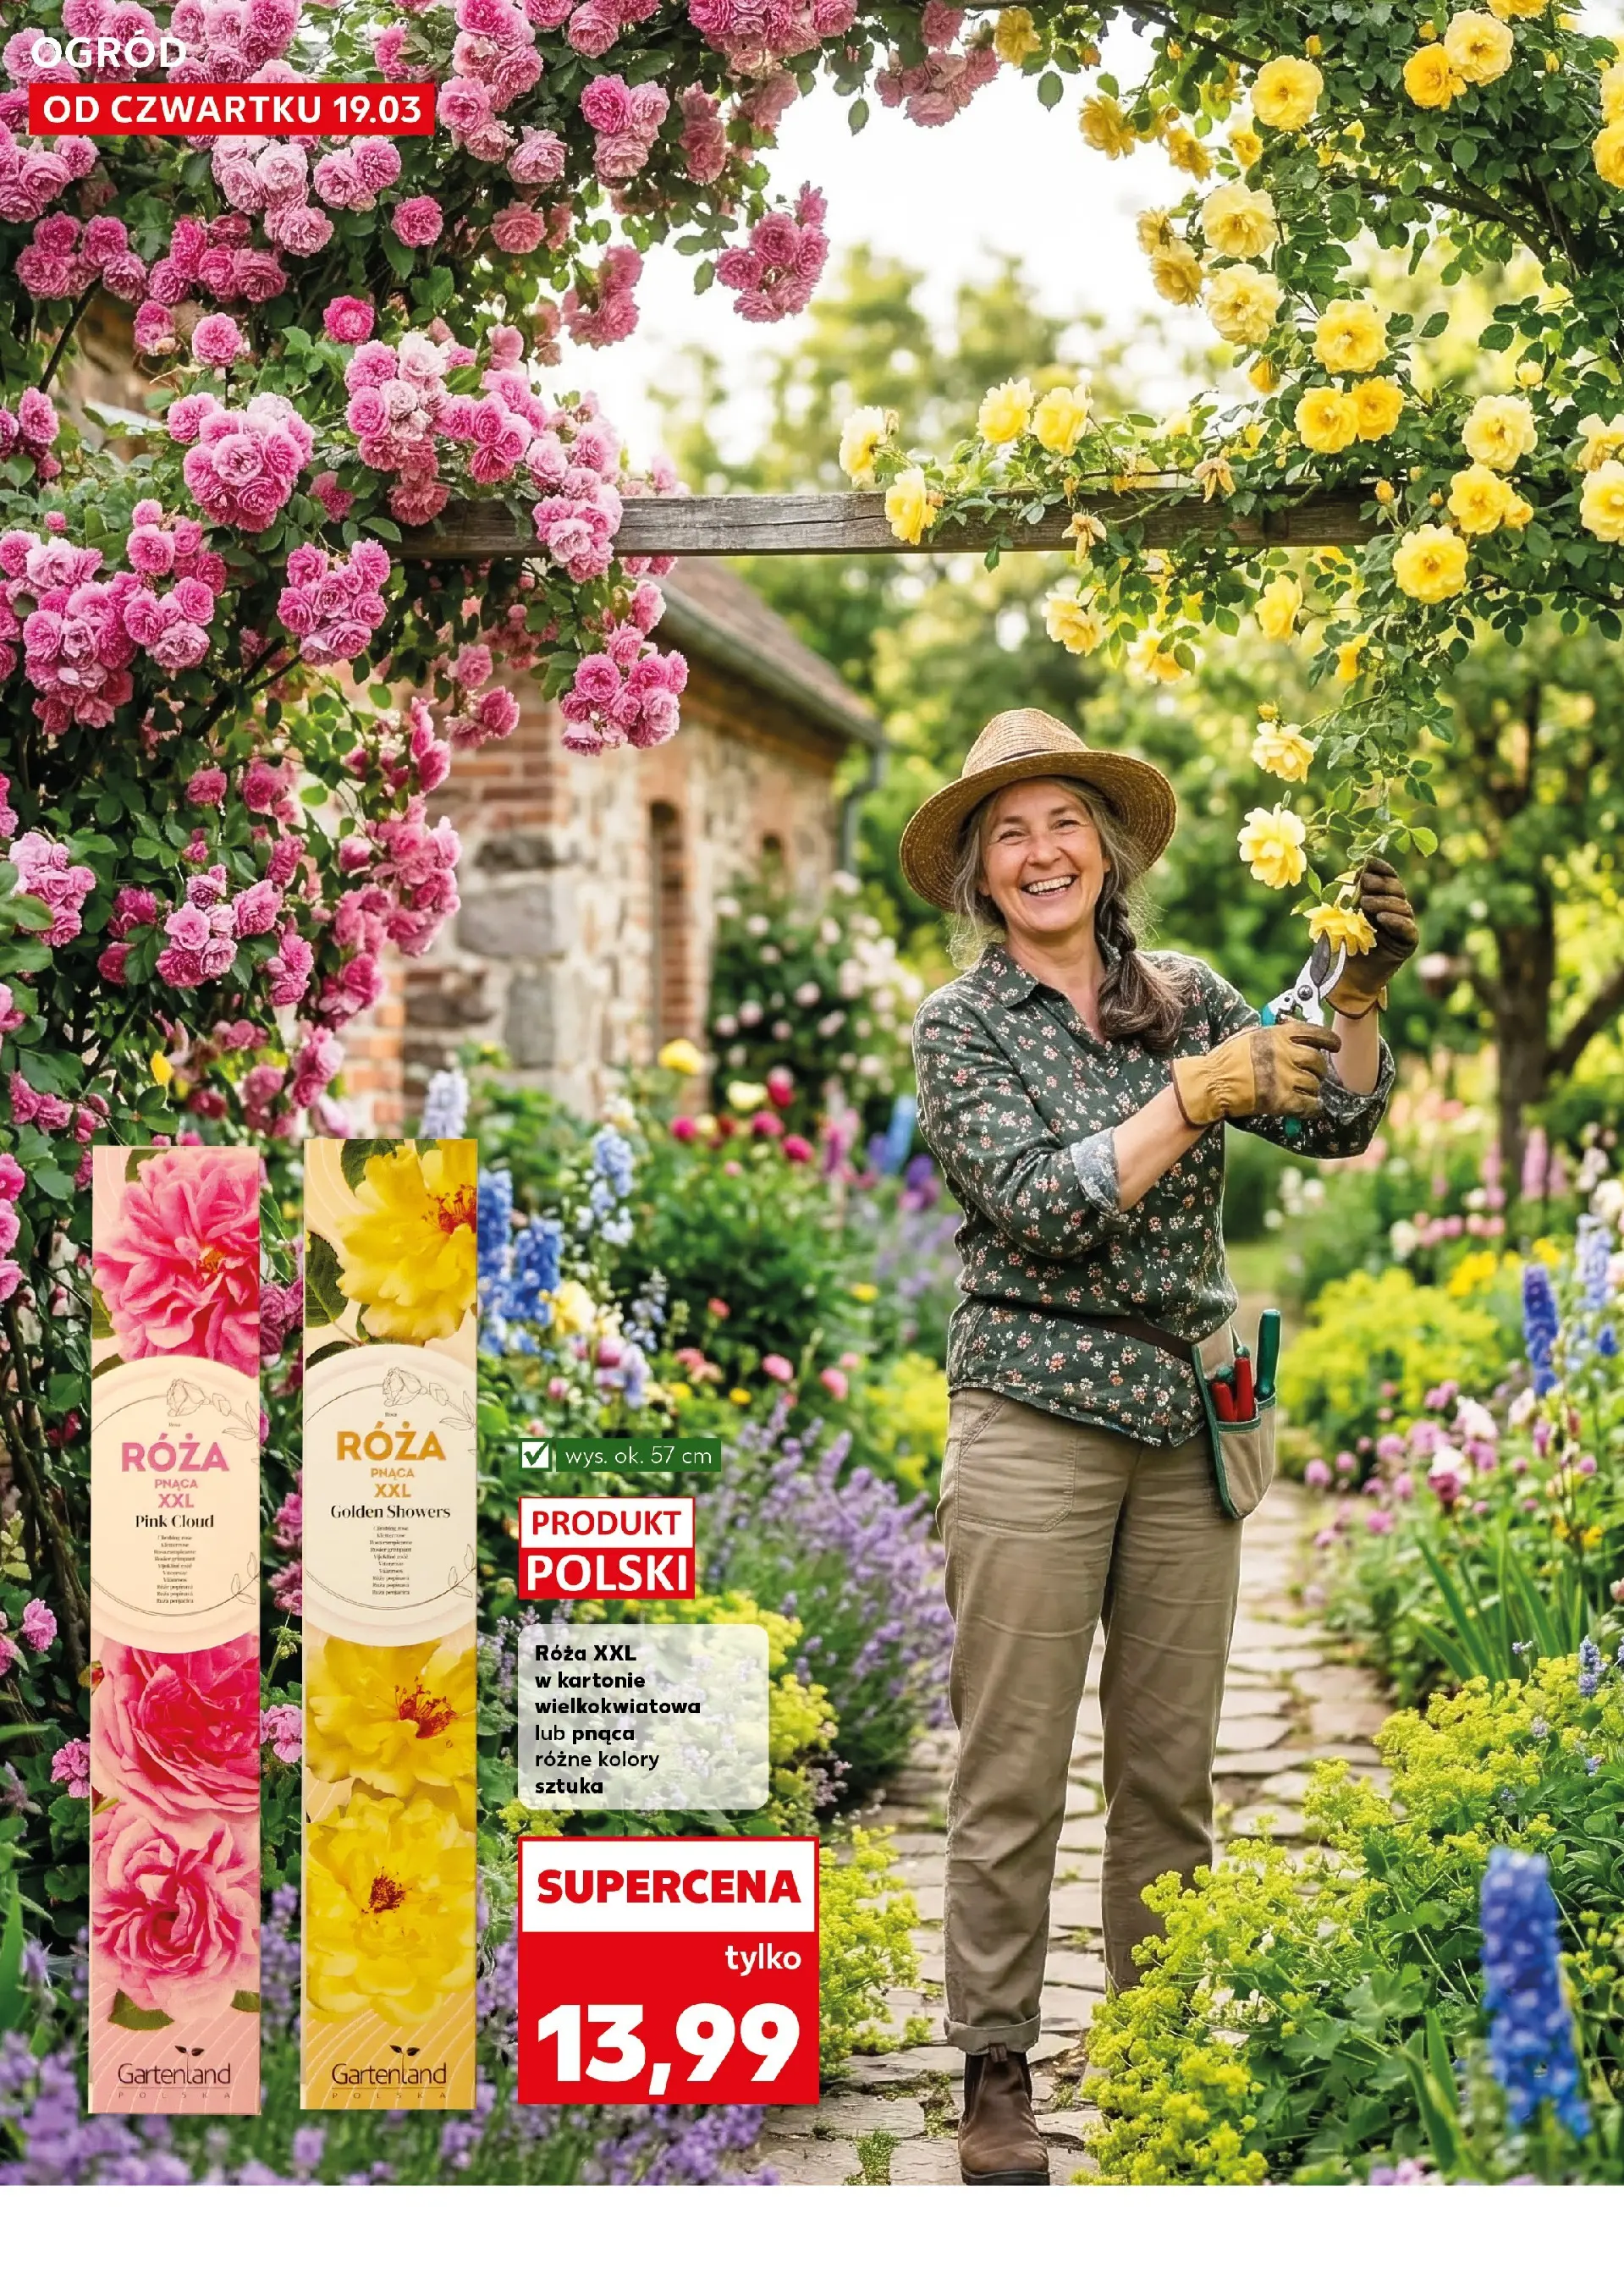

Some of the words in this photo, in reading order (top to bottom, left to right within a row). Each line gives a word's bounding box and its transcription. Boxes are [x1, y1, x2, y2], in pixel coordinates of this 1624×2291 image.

[121, 1433, 229, 1472] RÓŻA
[336, 1421, 446, 1461] RÓŻA
[154, 1479, 198, 1491] PNĄCA
[370, 1468, 415, 1480] PNĄCA
[157, 1493, 195, 1508] XXL
[373, 1484, 411, 1498] XXL
[135, 1514, 168, 1528] Pink
[171, 1514, 214, 1528] Cloud
[331, 1505, 383, 1519] Golden
[387, 1505, 450, 1519] Showers
[537, 1869, 801, 1904] SUPERCENA
[725, 1942, 801, 1977] tylko
[538, 2002, 800, 2095] 13,99
[118, 2062, 231, 2085] Gartenland
[332, 2062, 446, 2085] Gartenland
